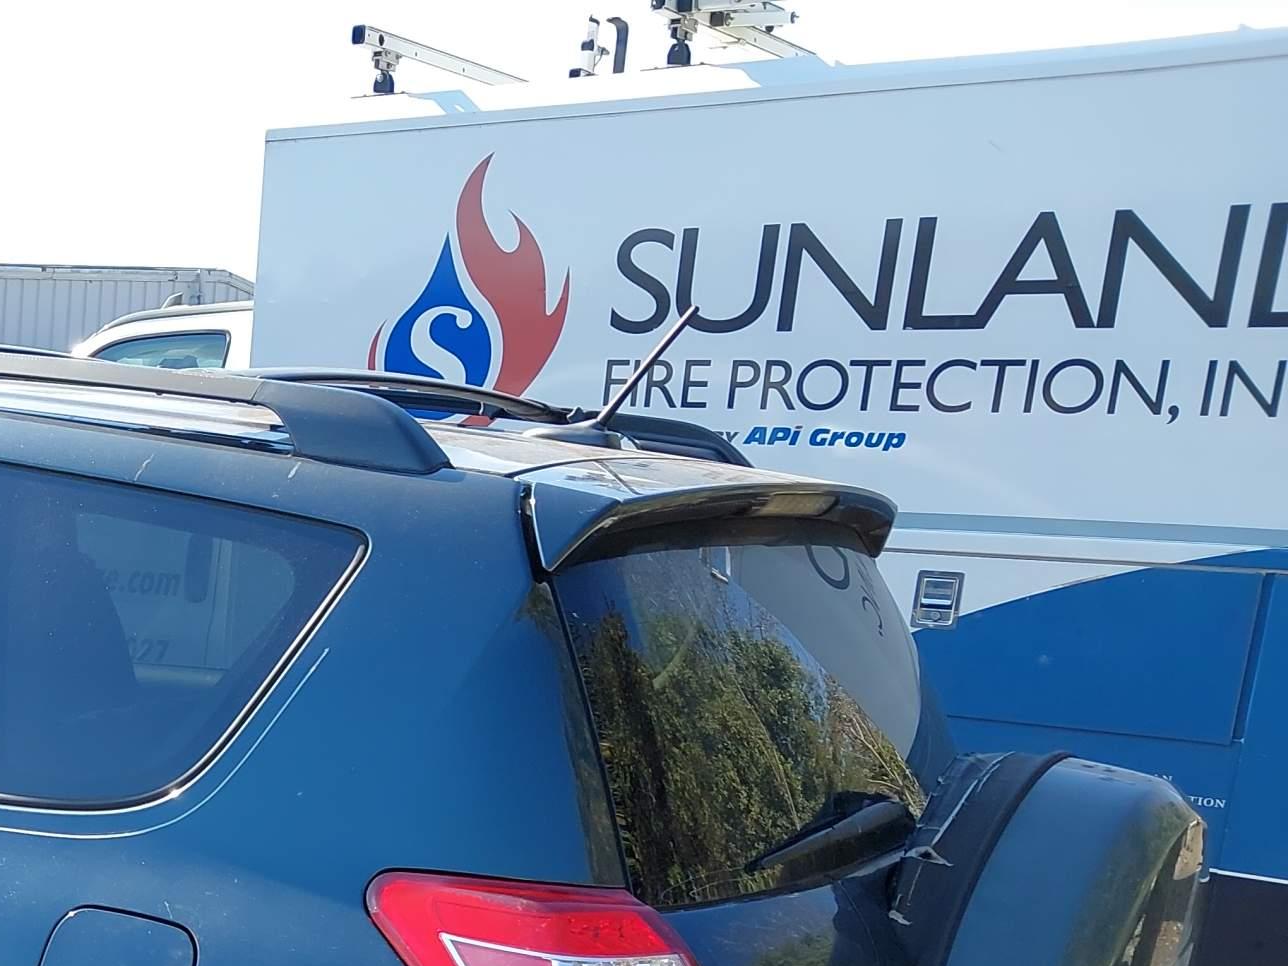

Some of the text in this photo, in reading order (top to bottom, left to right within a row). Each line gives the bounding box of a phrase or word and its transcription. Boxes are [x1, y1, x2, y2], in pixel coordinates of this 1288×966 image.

[601, 357, 709, 410] FIRE
[726, 358, 1180, 424] PROTECTION,
[742, 425, 803, 446] APi
[808, 428, 907, 452] Group
